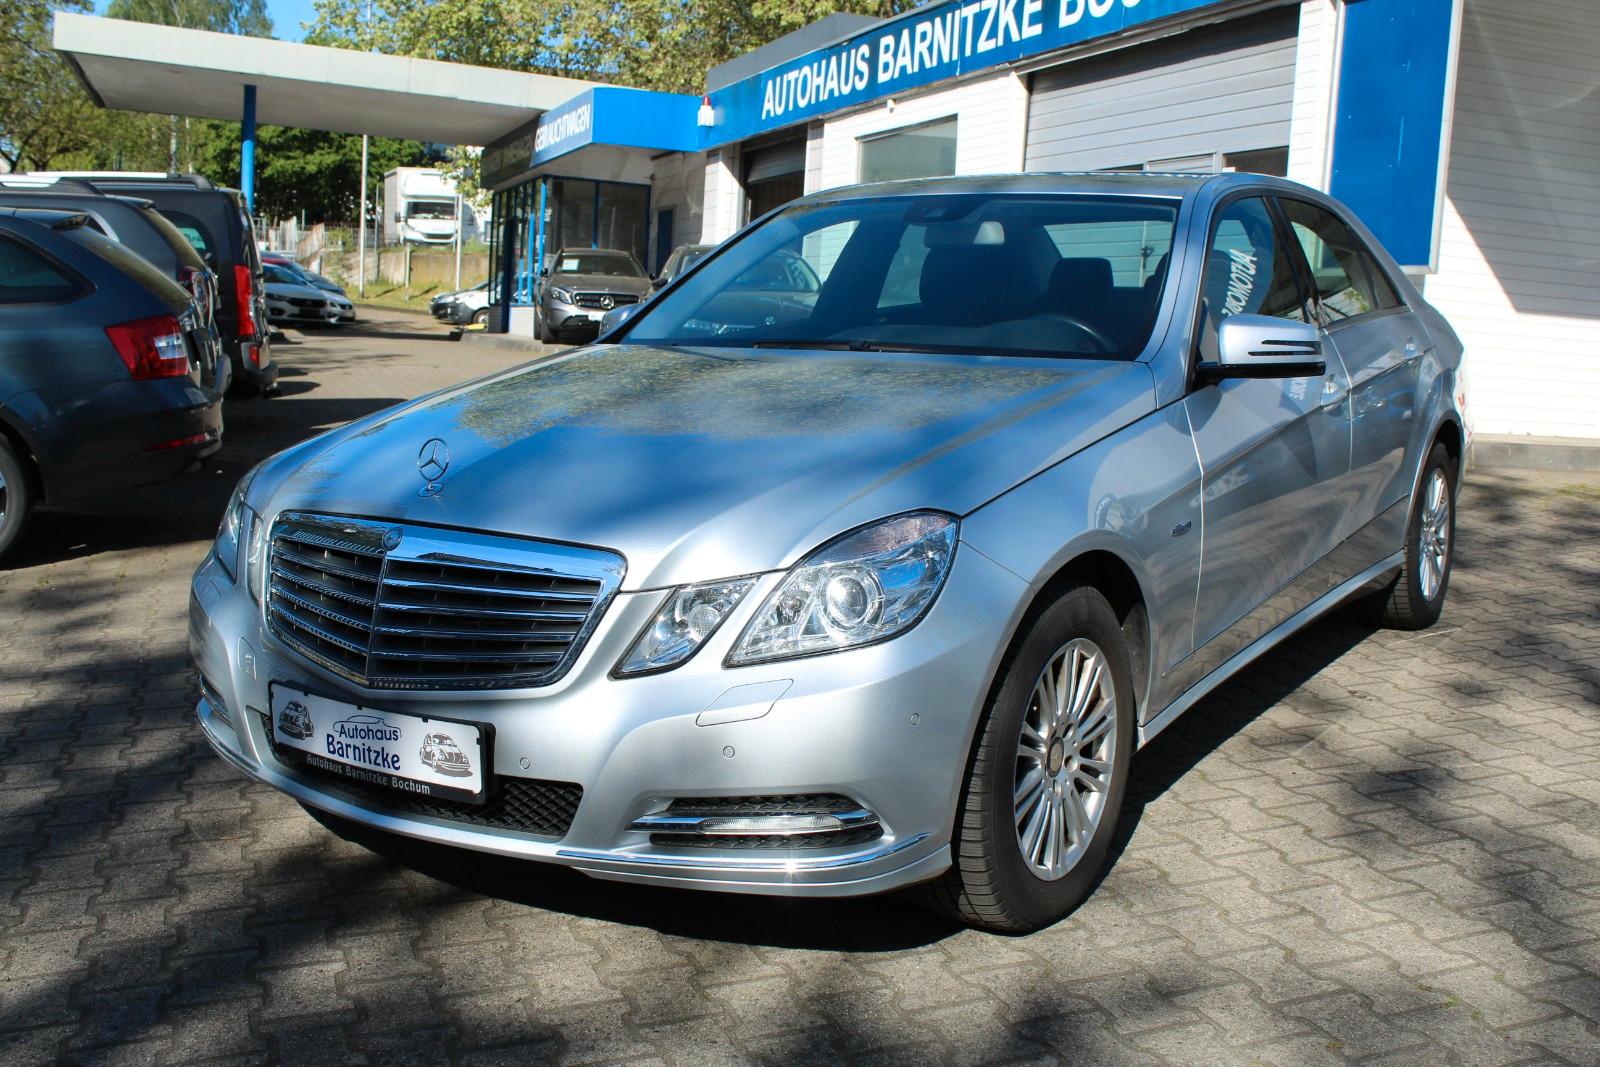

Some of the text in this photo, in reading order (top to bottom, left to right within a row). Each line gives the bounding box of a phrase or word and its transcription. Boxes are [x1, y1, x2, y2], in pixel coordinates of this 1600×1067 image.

[761, 0, 1042, 120] AUTOHAUS BARNITZKE
[339, 723, 399, 741] Autohaus
[326, 733, 401, 771] Barnitzke
[306, 754, 430, 795] Autohaus Barnitzke Bochum
